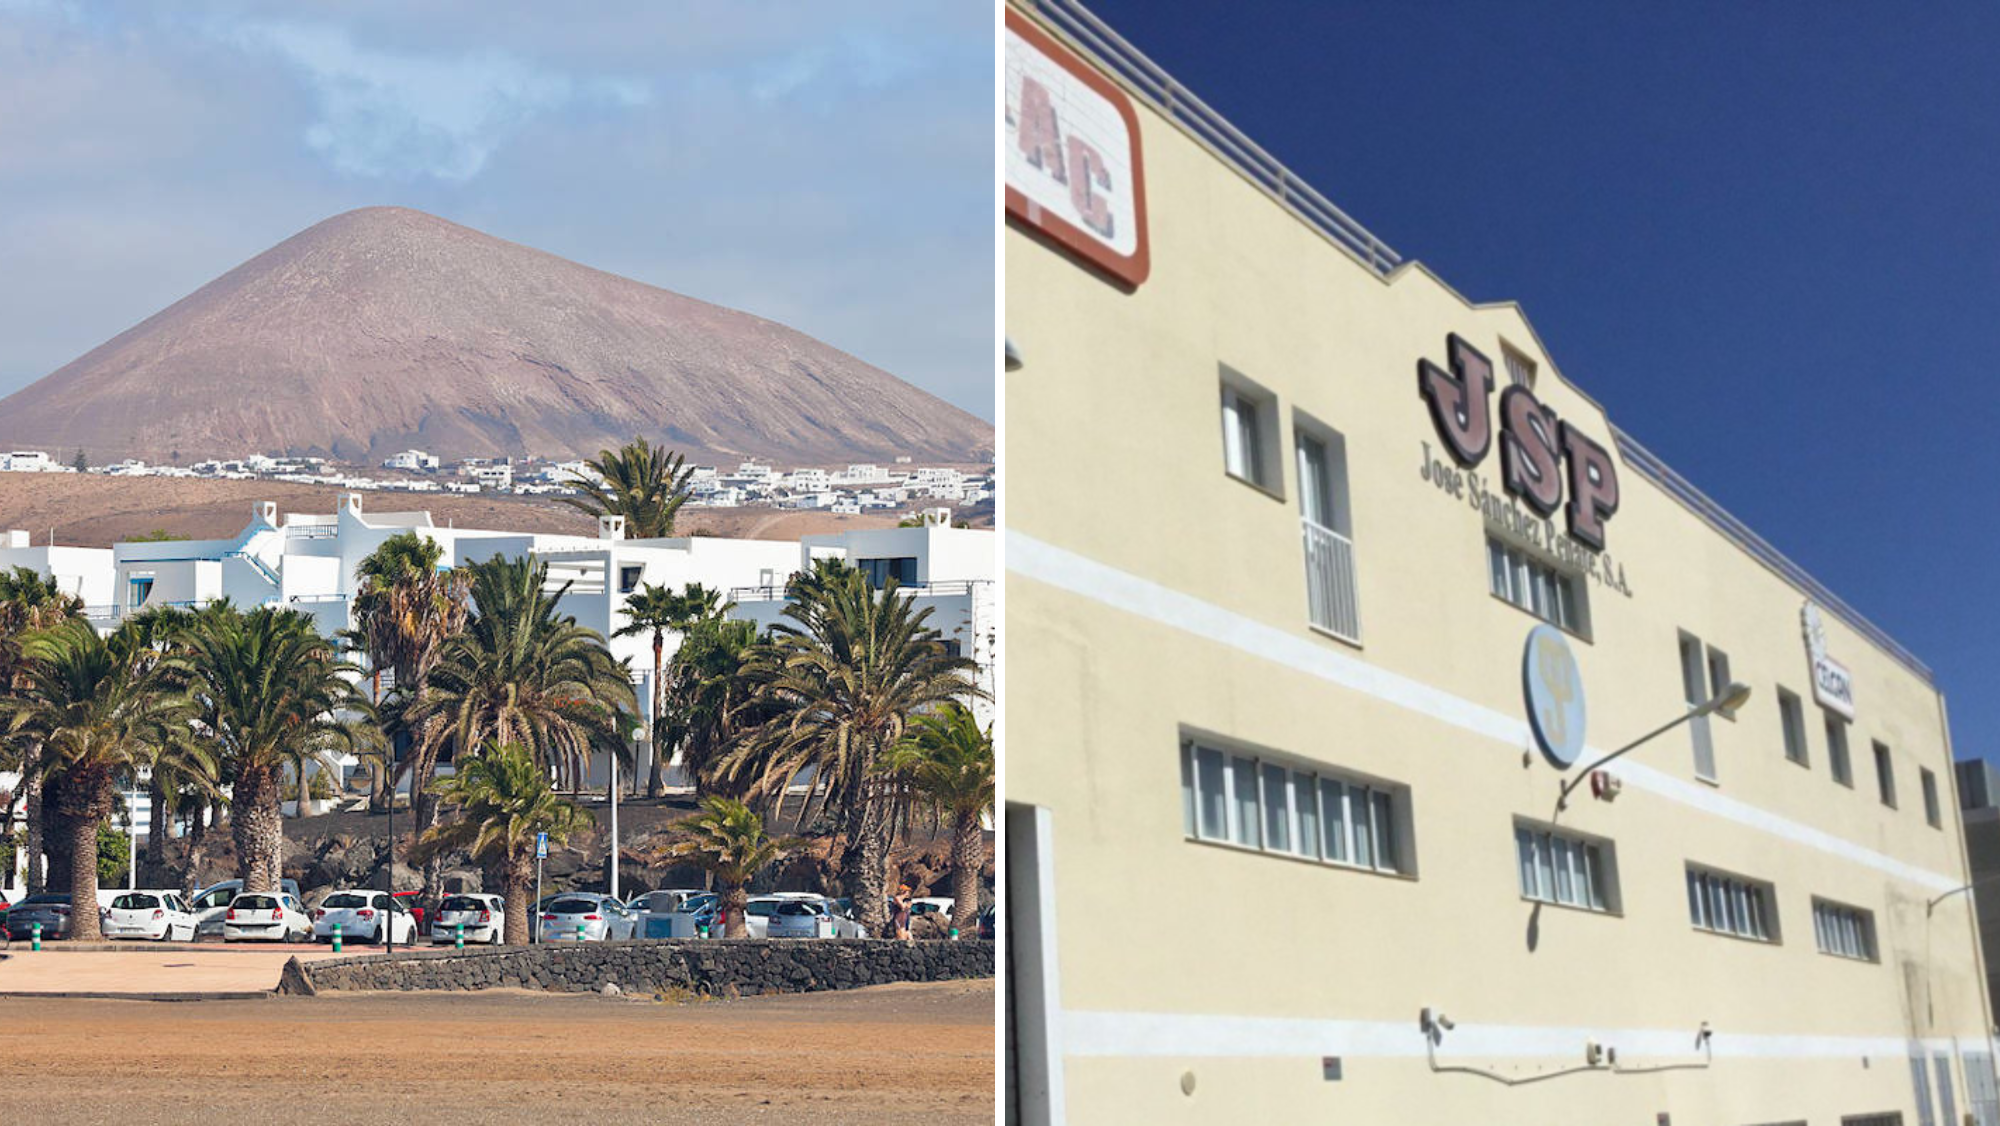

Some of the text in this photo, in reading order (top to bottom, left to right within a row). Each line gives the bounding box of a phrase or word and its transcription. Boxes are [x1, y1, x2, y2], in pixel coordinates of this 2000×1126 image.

[1005, 75, 1114, 239] AC
[1417, 332, 1619, 555] JSP
[1420, 440, 1464, 501] José
[1468, 471, 1541, 546] Sánchez
